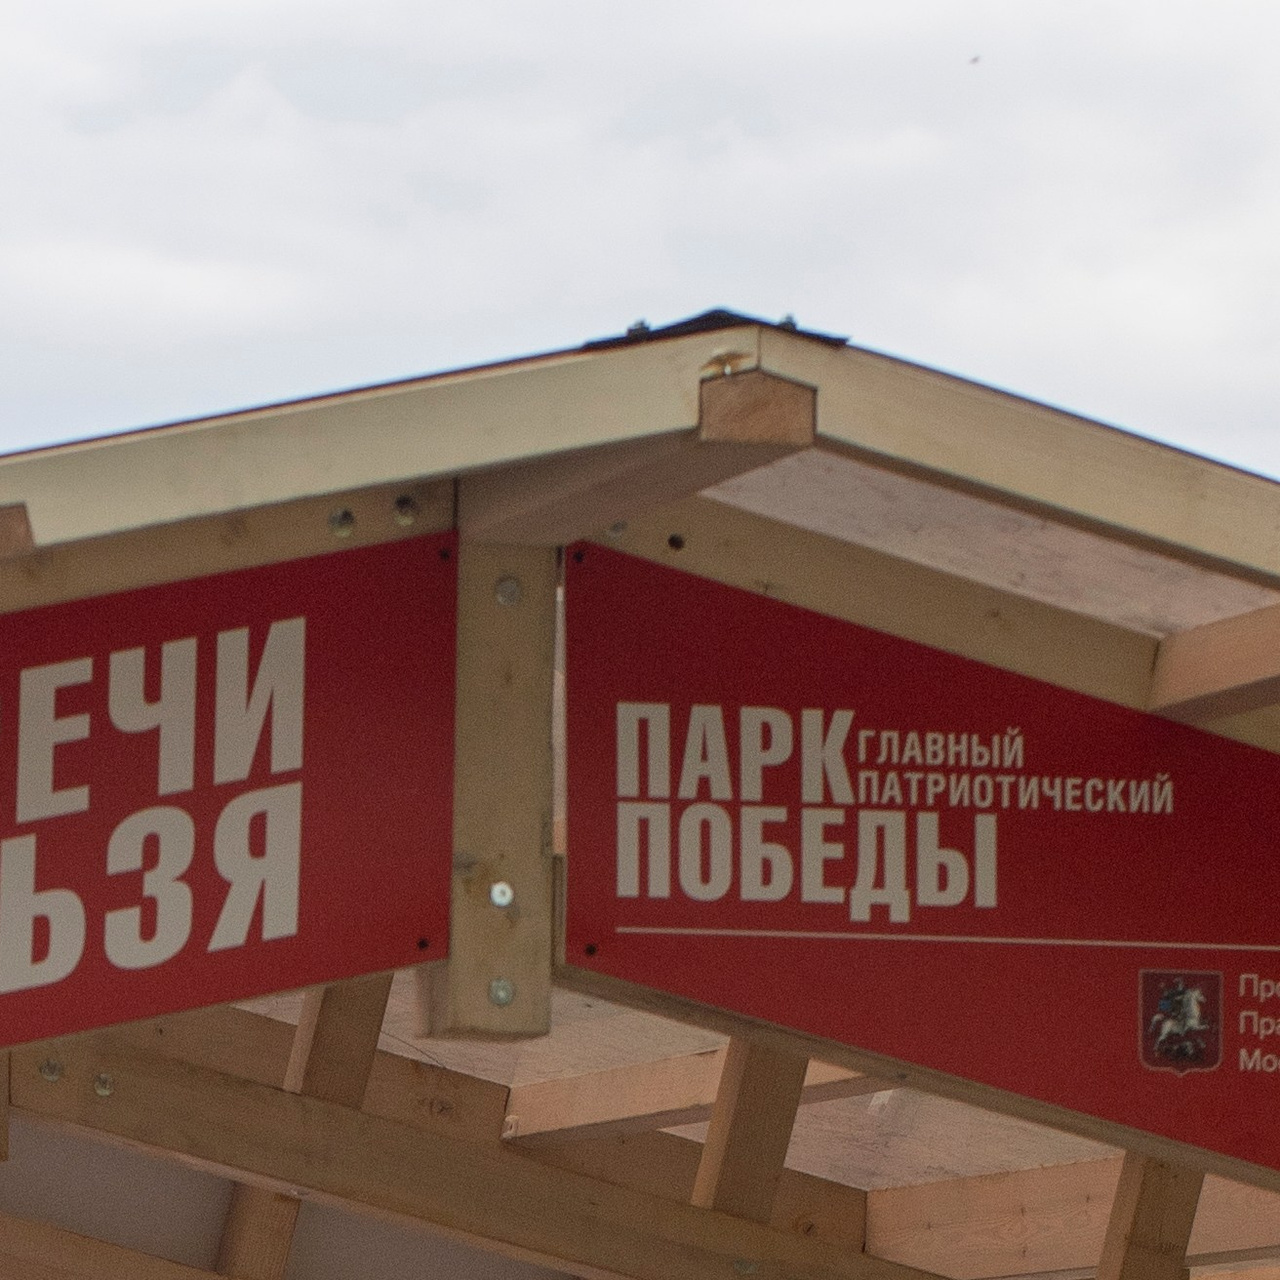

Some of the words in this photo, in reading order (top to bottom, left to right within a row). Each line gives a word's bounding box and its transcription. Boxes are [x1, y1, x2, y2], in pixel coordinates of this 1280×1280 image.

[617, 703, 854, 804] ПАРК
[858, 727, 1023, 768] ГЛАВНЫЙ
[858, 770, 1173, 814] ПАТРИОТИЧЕСКИЙ
[616, 802, 997, 923] ПОБЕДЫ
[1239, 1048, 1280, 1073] Мо
